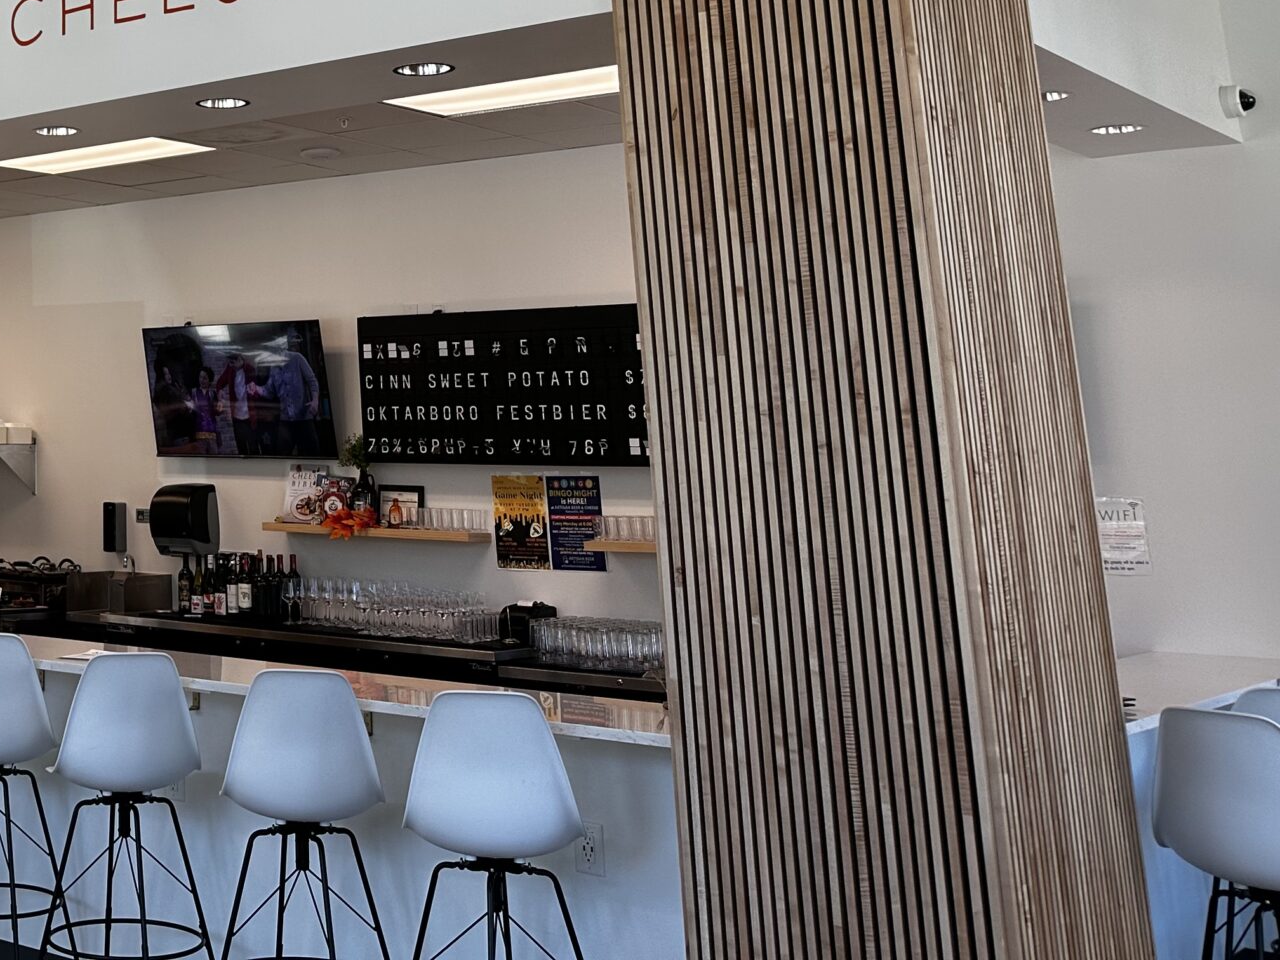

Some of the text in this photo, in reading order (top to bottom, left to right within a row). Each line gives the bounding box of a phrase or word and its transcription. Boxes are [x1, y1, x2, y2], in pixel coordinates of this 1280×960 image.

[365, 374, 411, 390] CINN
[427, 372, 489, 389] SWEET
[507, 370, 589, 387] POTATO
[367, 405, 478, 421] OKTARBORO
[496, 404, 607, 420] FESTBIER
[495, 491, 543, 501] Game Night
[549, 489, 597, 497] BINGO NIGHT
